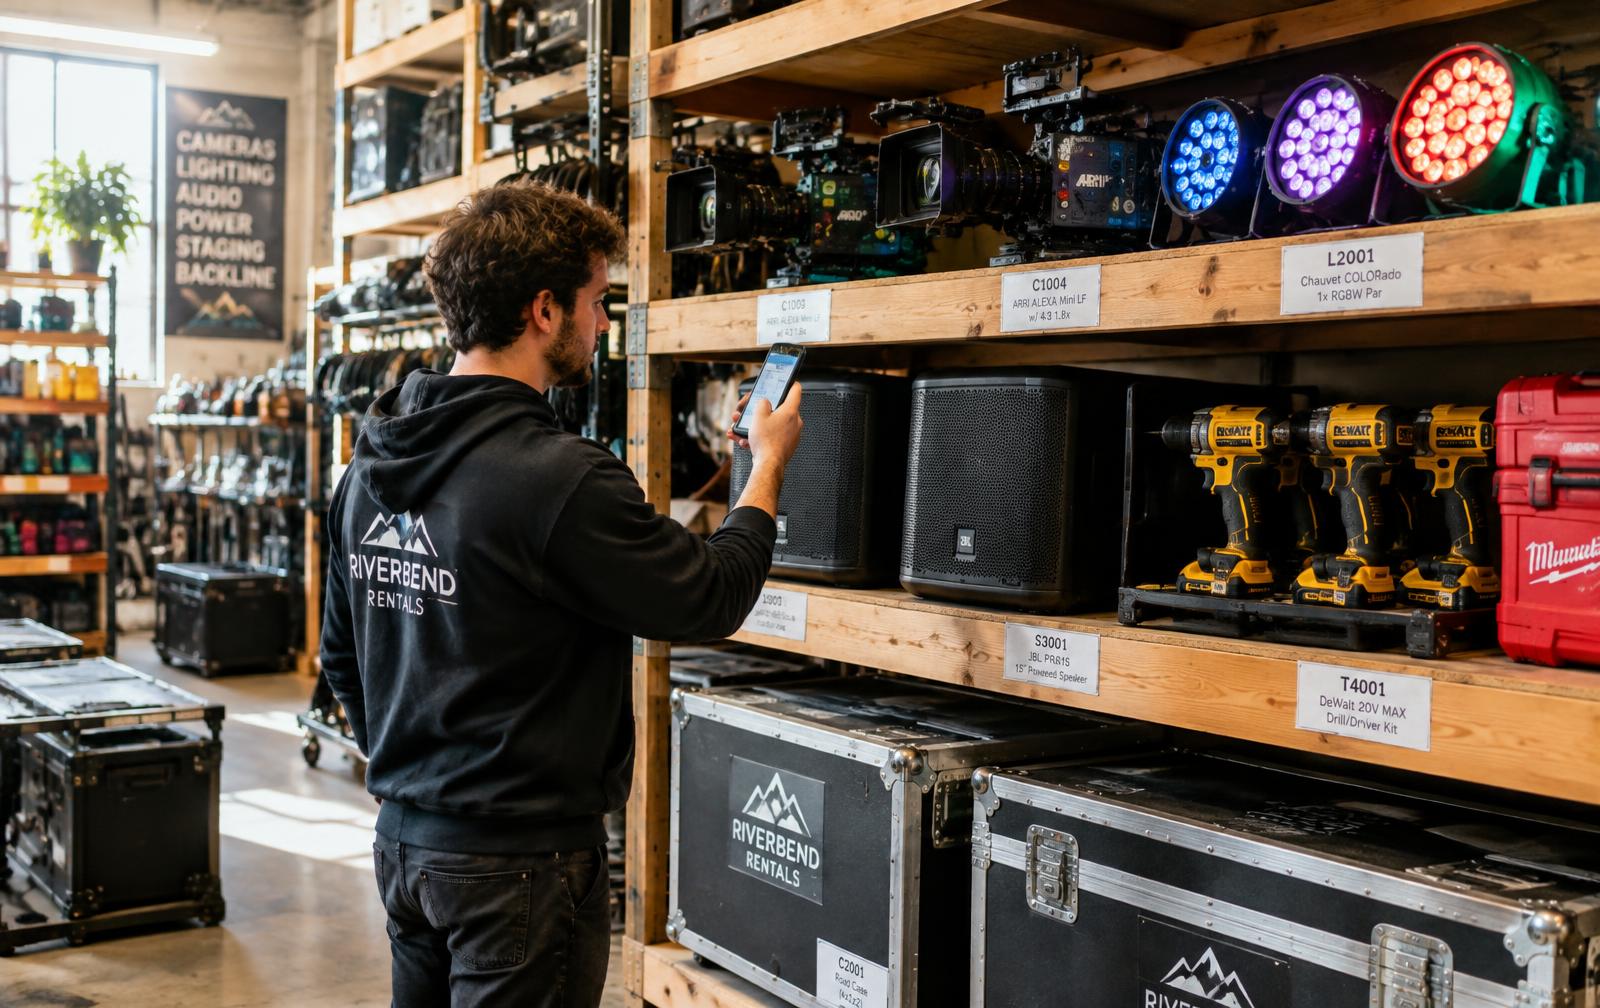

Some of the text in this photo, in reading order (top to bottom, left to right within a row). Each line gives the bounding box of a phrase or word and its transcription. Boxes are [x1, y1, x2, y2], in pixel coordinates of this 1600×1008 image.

[176, 130, 277, 161] CAMERAS
[176, 155, 275, 186] LIGHTING
[176, 182, 243, 209] AUDIO
[175, 208, 253, 235] POWER
[175, 234, 266, 263] STAGING
[1328, 248, 1374, 267] L2001
[175, 261, 276, 289] BACKLINE
[1032, 277, 1067, 292] C1004
[1300, 269, 1402, 287] Chauvet COLORado
[1032, 297, 1058, 308] ALEXA
[1317, 287, 1383, 302] 1x RGBW Par
[350, 554, 456, 597] RIVERBEND
[368, 590, 424, 615] RENTALS
[1035, 634, 1067, 651] S3001
[1340, 676, 1386, 697] T4001
[1319, 695, 1407, 720] DeWalt 20V MAX
[1383, 722, 1398, 735] Kit
[732, 818, 820, 870] RIVERBEND
[746, 851, 800, 888] RENTALS
[838, 956, 864, 978] C2001
